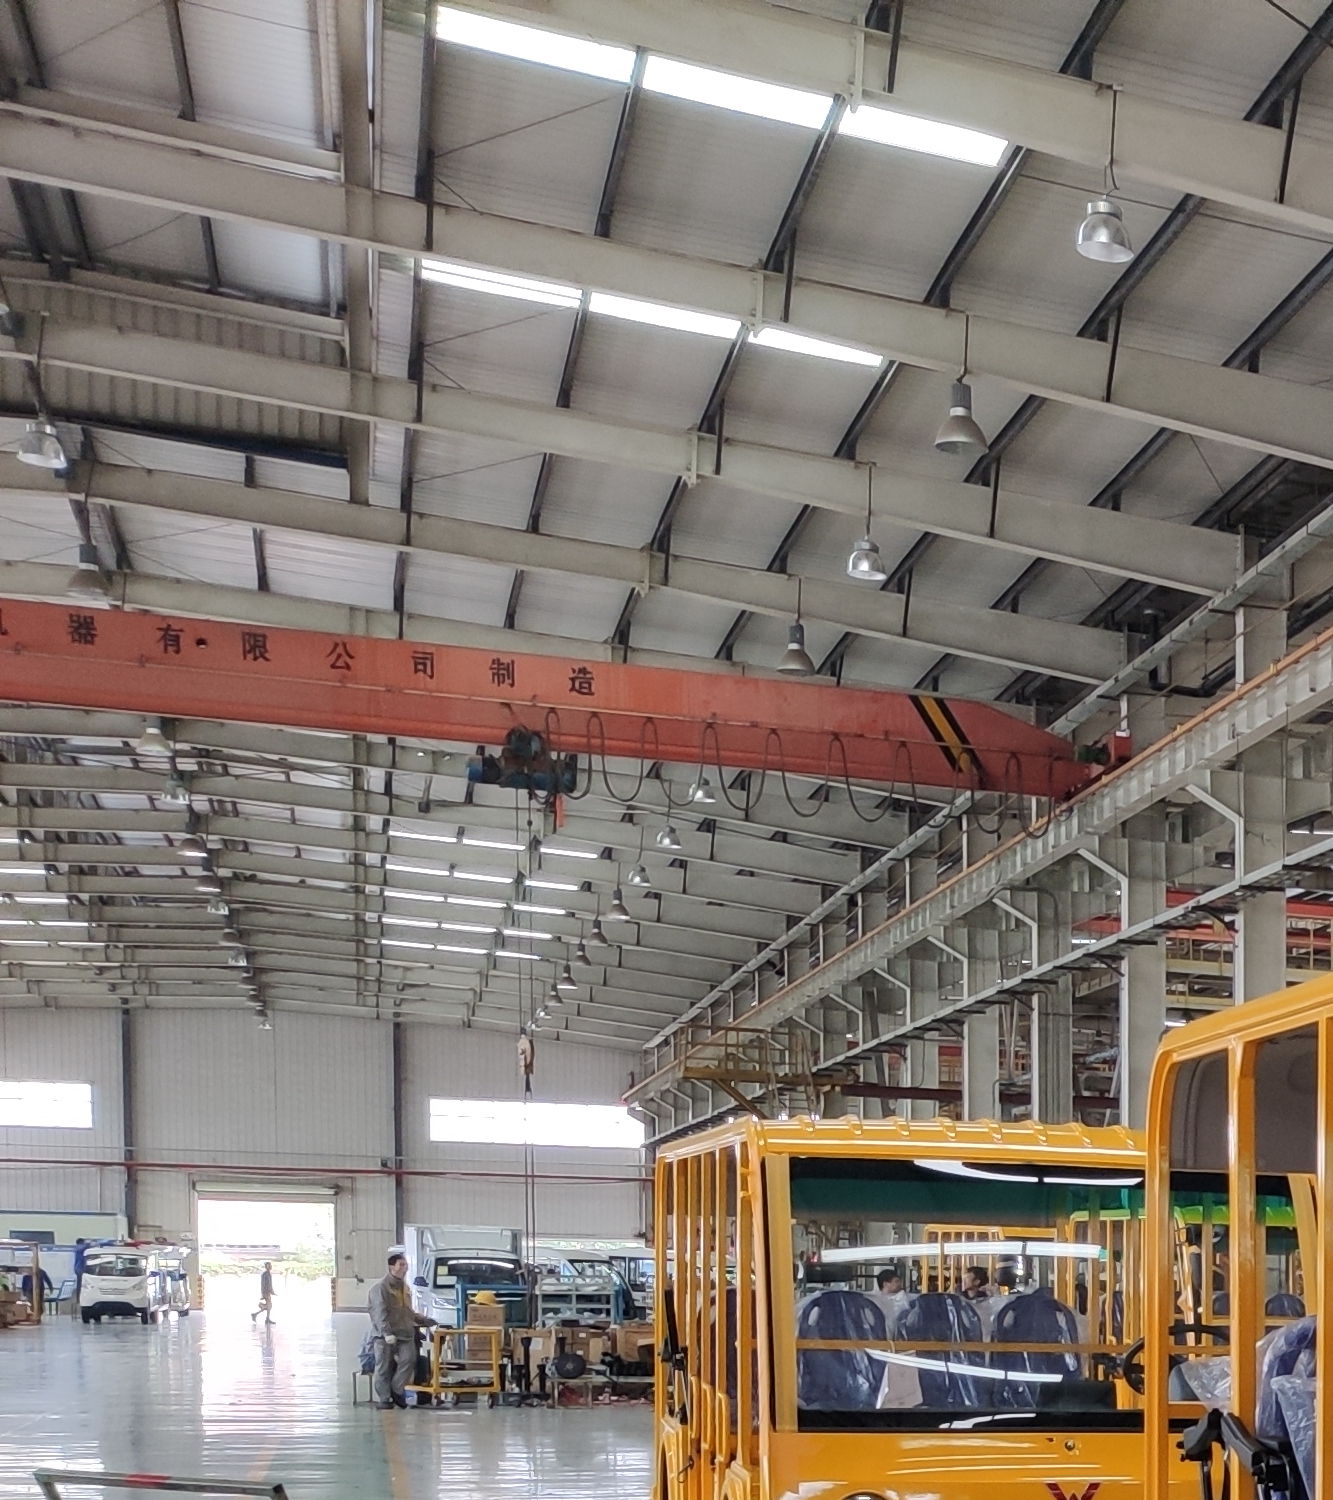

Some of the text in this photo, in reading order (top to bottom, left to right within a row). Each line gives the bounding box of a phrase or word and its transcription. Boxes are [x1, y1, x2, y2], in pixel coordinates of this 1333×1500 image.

[0, 609, 596, 697] 器有限公司制造
